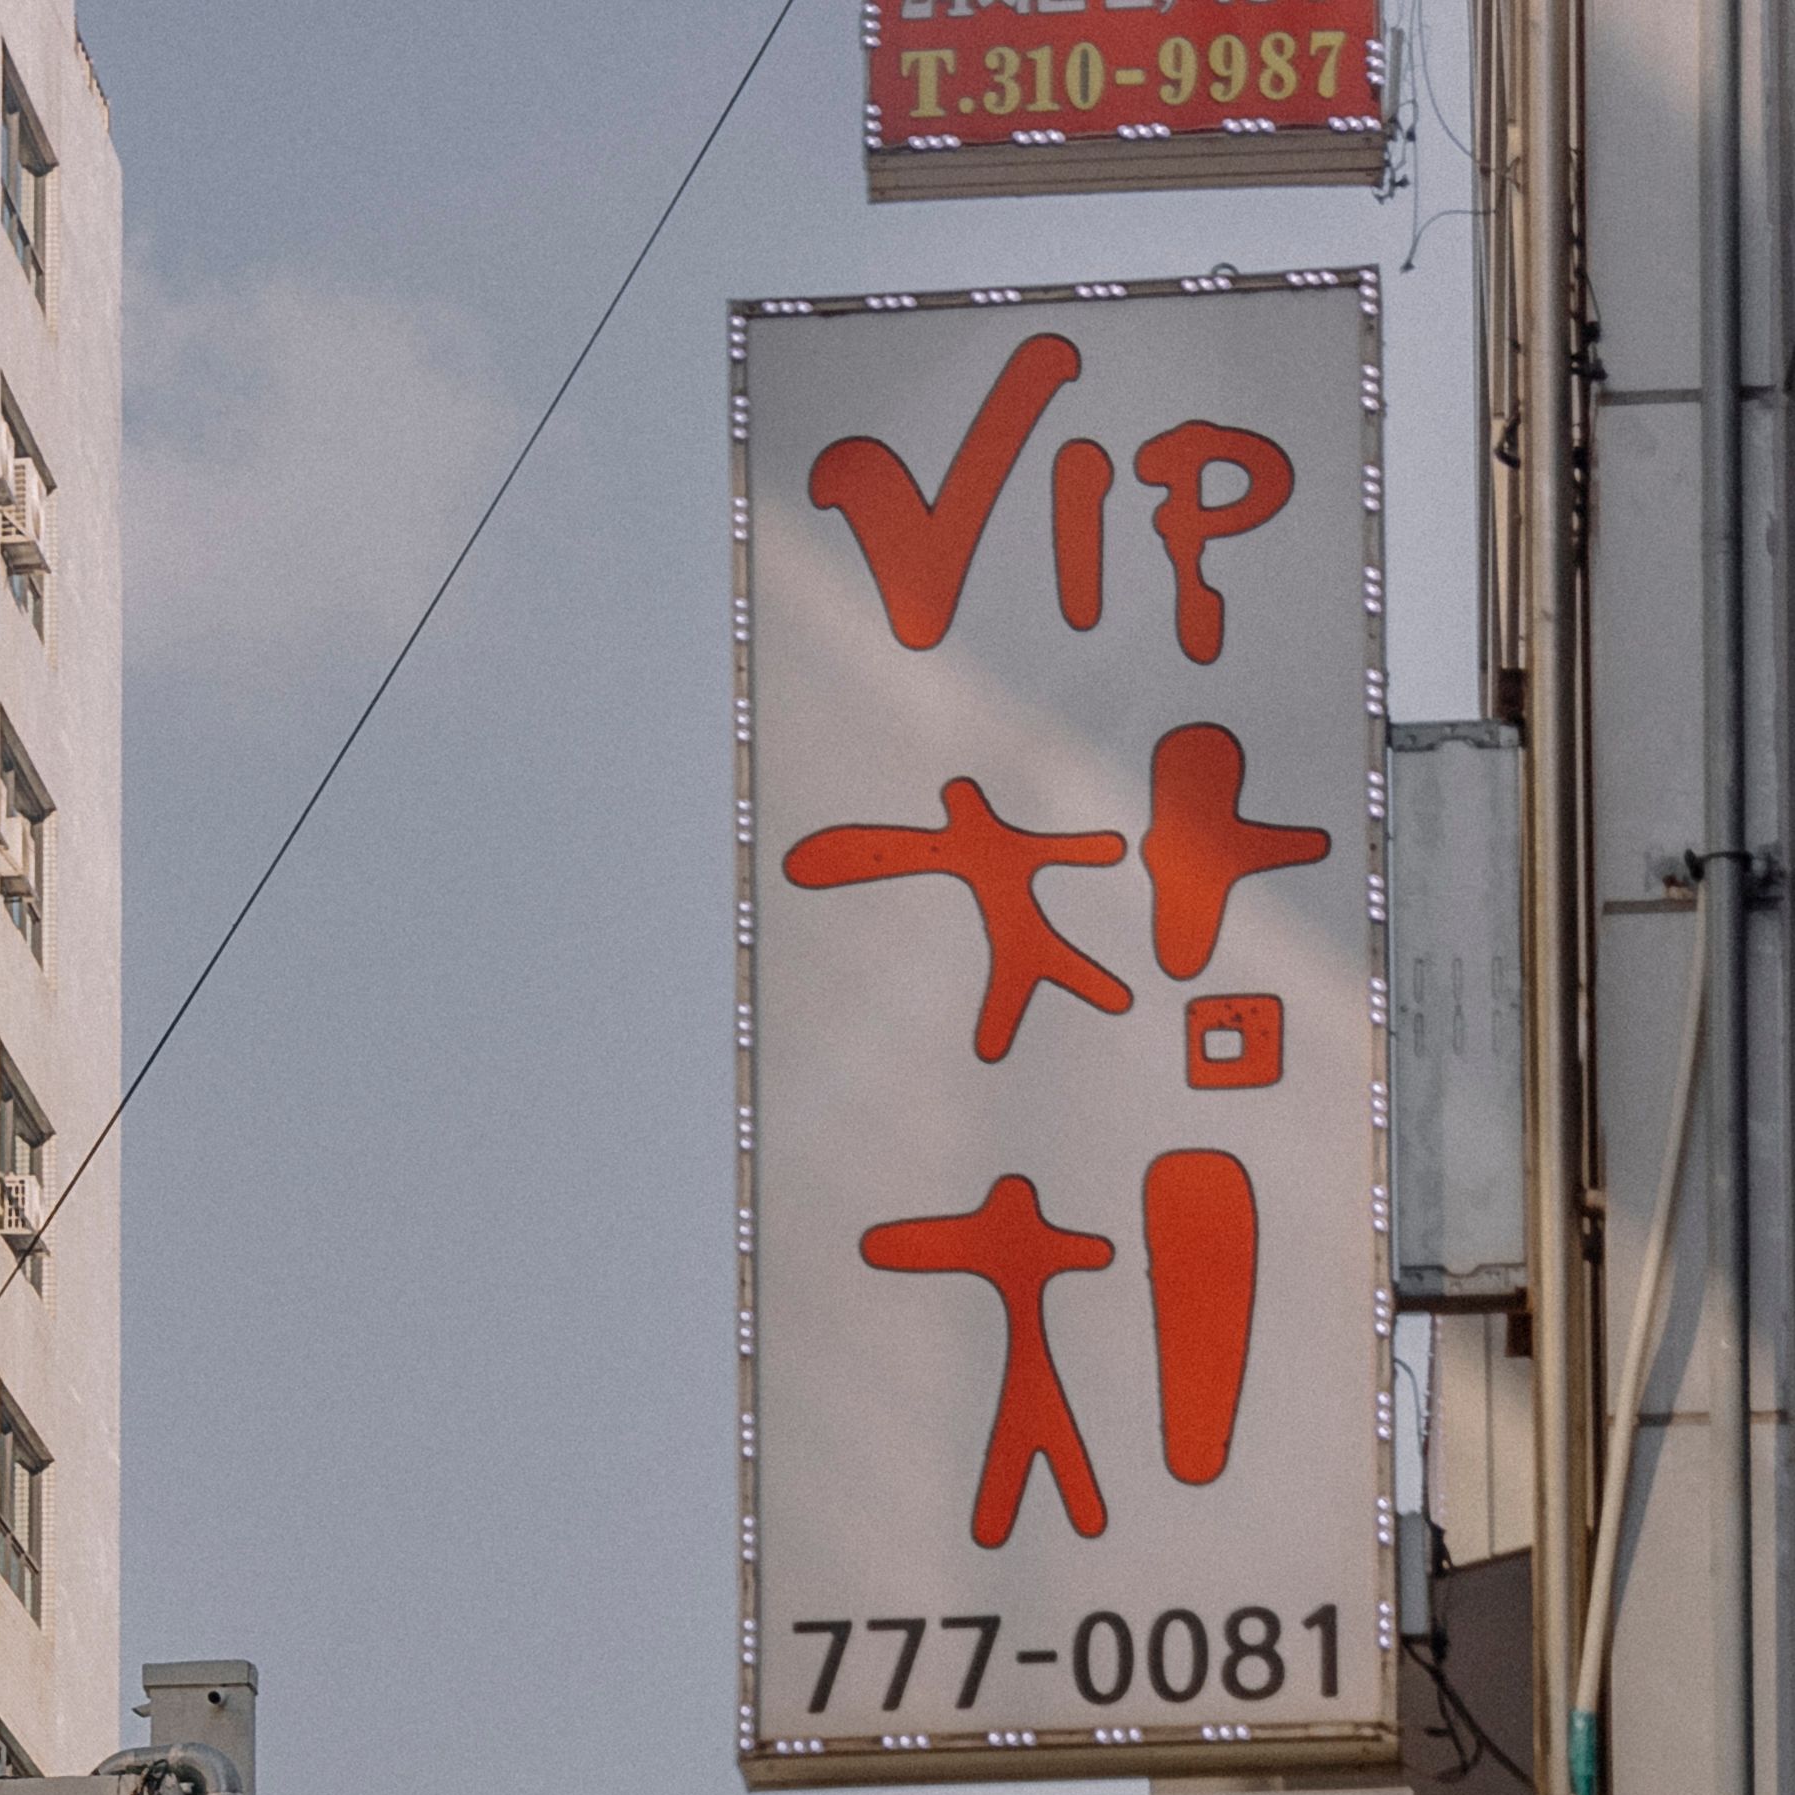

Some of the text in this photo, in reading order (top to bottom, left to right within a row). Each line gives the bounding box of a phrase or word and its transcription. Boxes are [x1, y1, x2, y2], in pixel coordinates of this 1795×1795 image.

[900, 30, 1347, 119] T.310-9987
[807, 333, 1295, 665] VIP
[782, 723, 1332, 1551] 참치
[791, 1603, 1345, 1714] 777-0081
